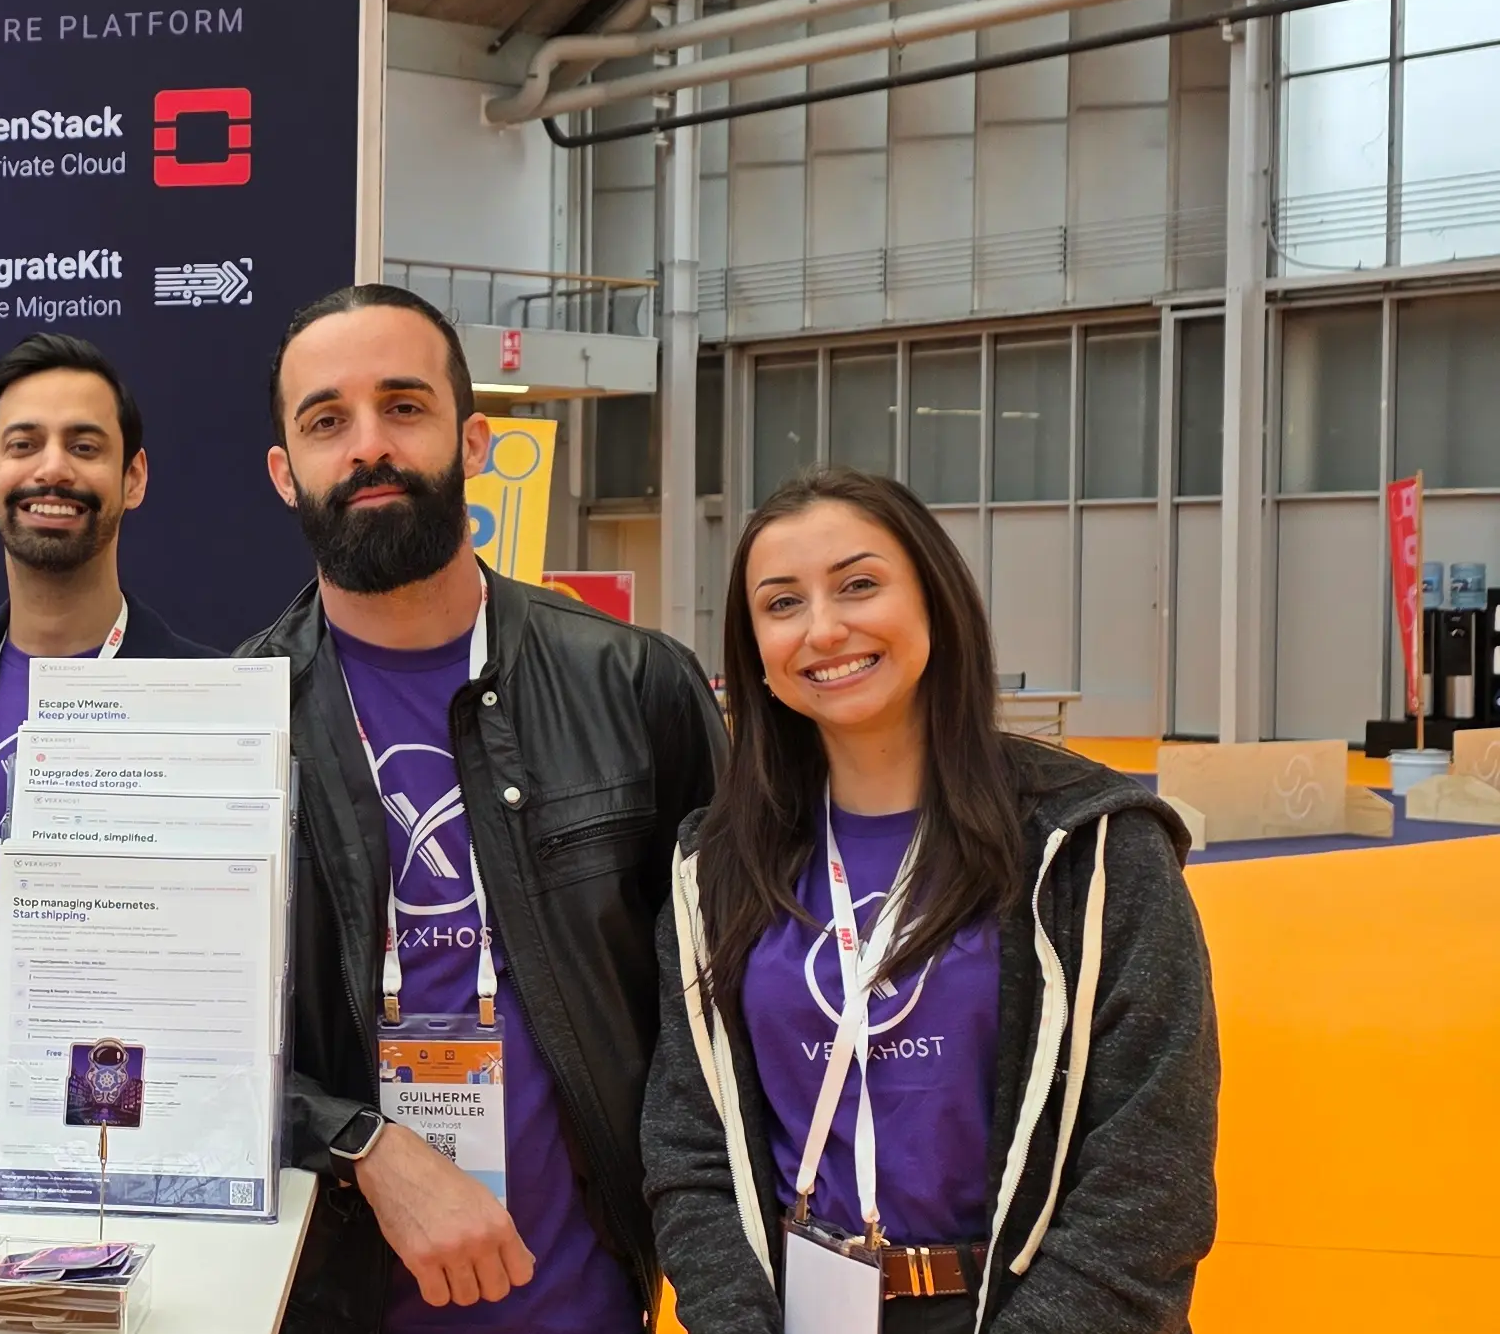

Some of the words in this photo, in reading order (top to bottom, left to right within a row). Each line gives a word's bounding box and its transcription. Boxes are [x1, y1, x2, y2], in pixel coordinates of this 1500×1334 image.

[59, 7, 244, 40] PLATFORM
[60, 150, 126, 176] Cloud
[16, 294, 122, 323] Migration
[38, 699, 75, 710] Escape
[77, 700, 123, 709] VMware.
[38, 710, 65, 720] Keep
[66, 713, 89, 721] your
[90, 711, 130, 721] uptime.
[29, 768, 41, 777] 10
[42, 769, 93, 778] upgrades.
[94, 769, 118, 777] Zero
[119, 769, 142, 777] data
[143, 769, 167, 778] loss.
[99, 780, 142, 789] storage.
[32, 831, 68, 840] Private
[69, 832, 102, 842] cloud,
[103, 833, 158, 844] simplified.
[13, 897, 39, 909] Stop
[40, 899, 93, 911] managing
[94, 898, 159, 911] Kubernetes.
[12, 910, 40, 920] Start
[41, 910, 90, 922] shipping.
[45, 1049, 63, 1057] Free
[399, 1091, 482, 1103] GUILHERME
[396, 1103, 485, 1117] STEINMÜLLER
